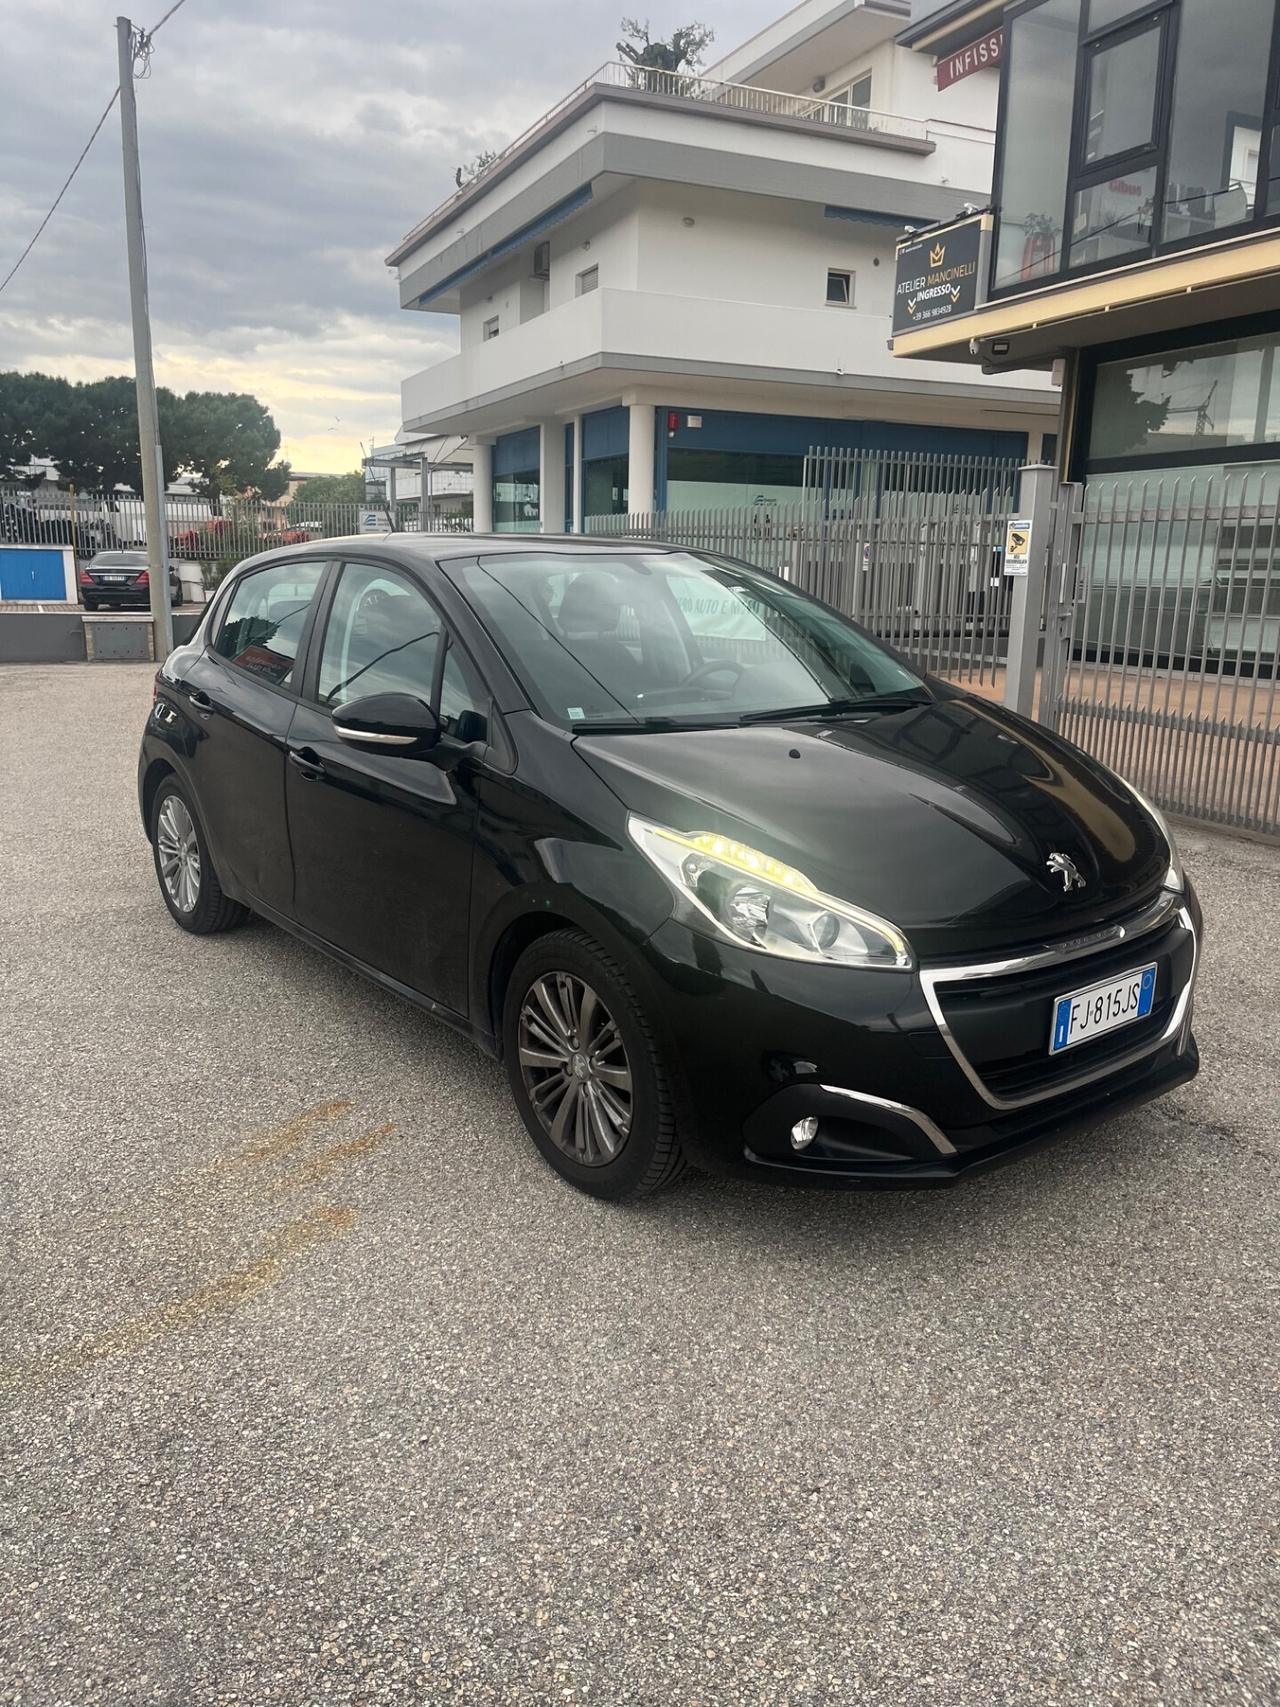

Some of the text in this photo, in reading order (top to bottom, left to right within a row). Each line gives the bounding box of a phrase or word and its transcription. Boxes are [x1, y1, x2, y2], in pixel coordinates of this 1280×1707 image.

[896, 261, 976, 296] ATELIER MANCINELLI
[917, 283, 951, 302] INGRESSO
